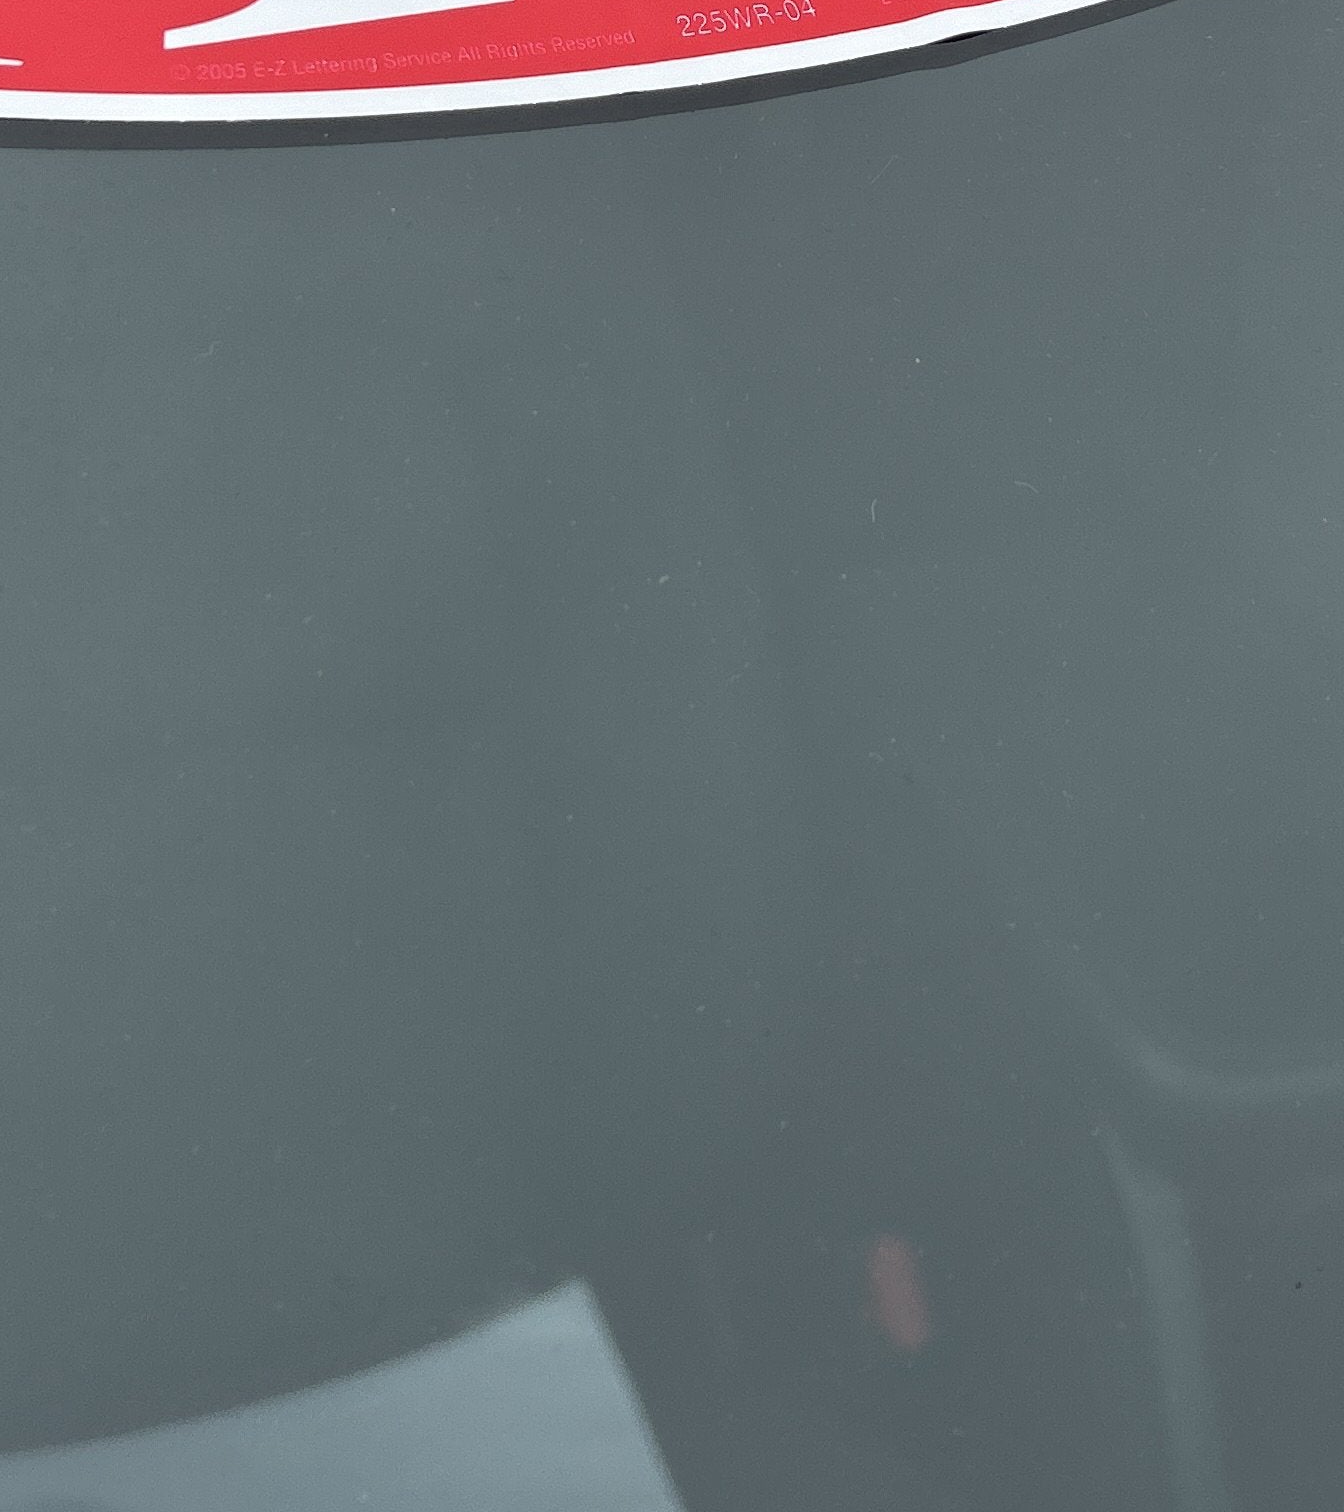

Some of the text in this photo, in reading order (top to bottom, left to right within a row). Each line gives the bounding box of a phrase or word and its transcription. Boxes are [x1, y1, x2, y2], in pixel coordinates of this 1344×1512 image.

[195, 61, 247, 81] 2005
[254, 59, 288, 78] E-Z
[293, 56, 378, 76] Lettering
[383, 50, 452, 70] Service
[458, 45, 481, 62] All
[486, 40, 547, 60] Rights
[552, 29, 636, 54] Reserved
